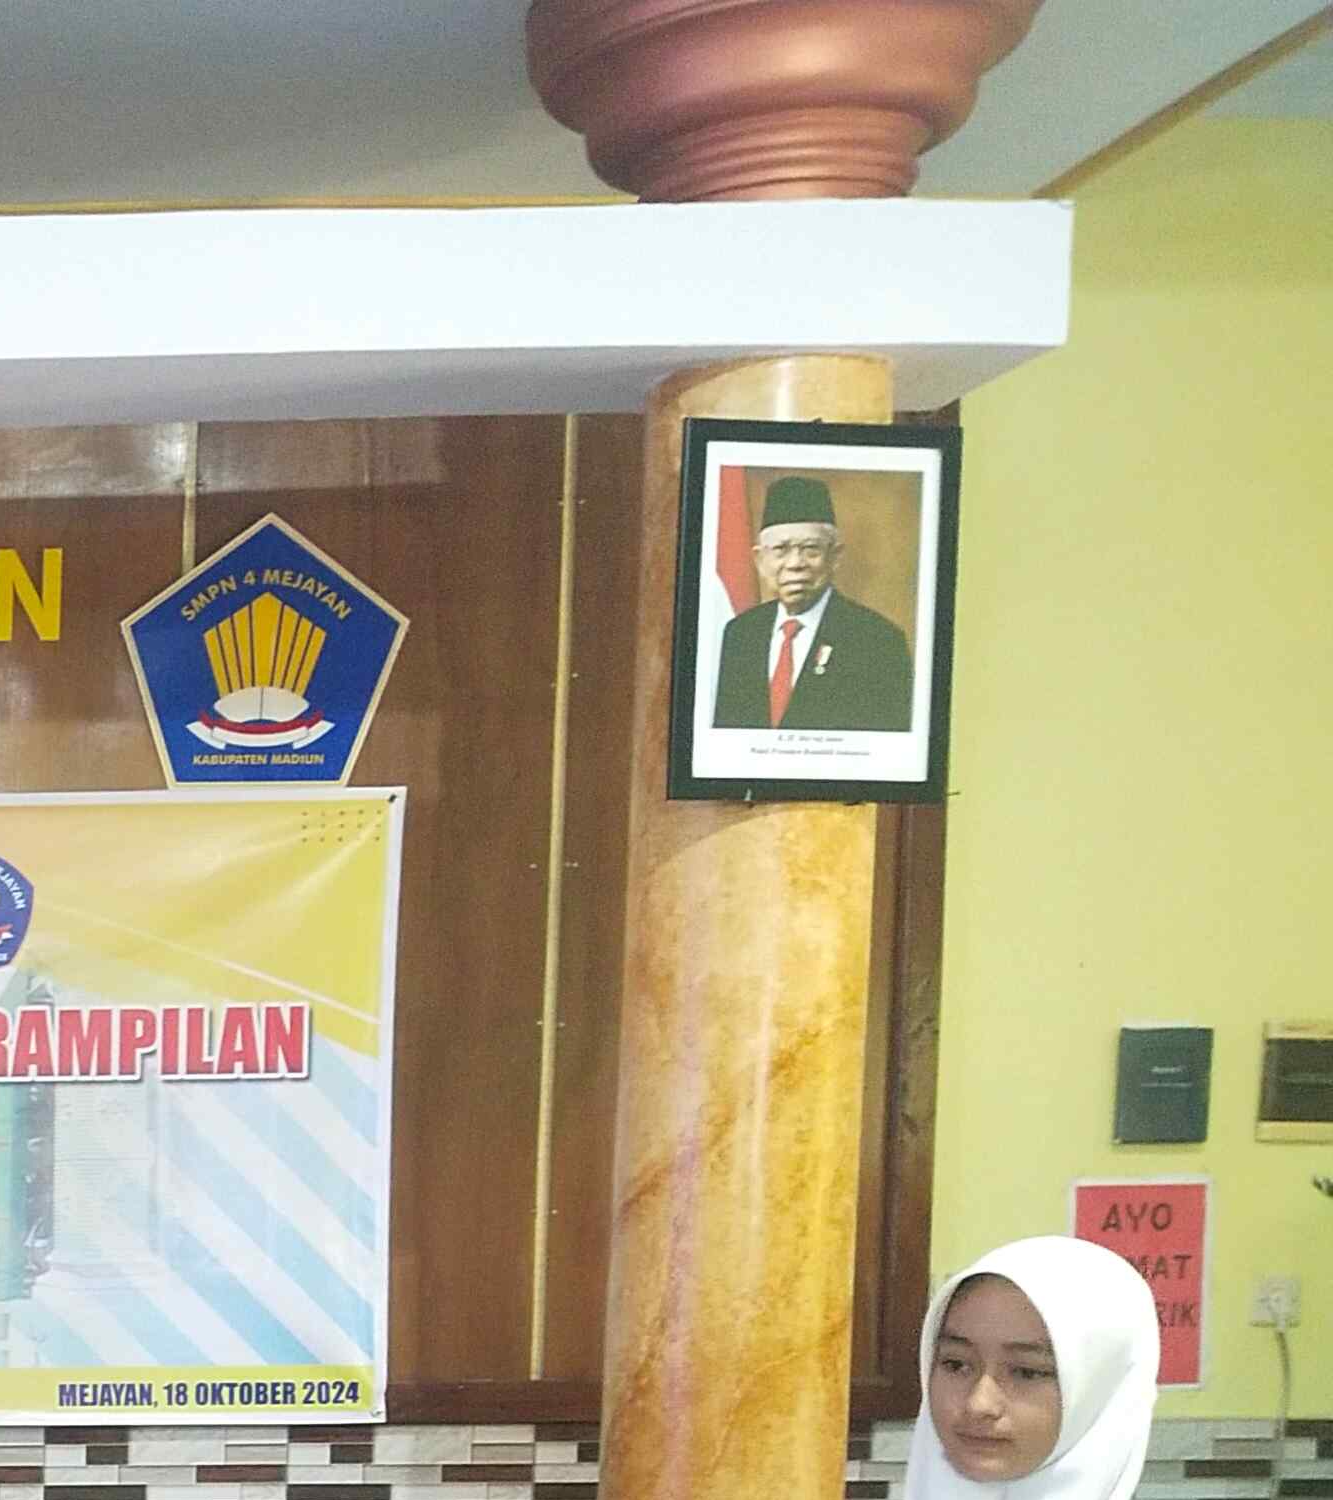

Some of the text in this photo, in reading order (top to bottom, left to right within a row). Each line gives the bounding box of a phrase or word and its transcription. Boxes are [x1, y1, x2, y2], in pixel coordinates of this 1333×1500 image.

[181, 568, 354, 622] SMPN 4 MEJAYAN
[192, 753, 325, 766] KABUPATEN MADIUN
[1100, 1203, 1173, 1233] AYO
[58, 1381, 360, 1408] MEJAYAN, 18 OKTOBER 2024
